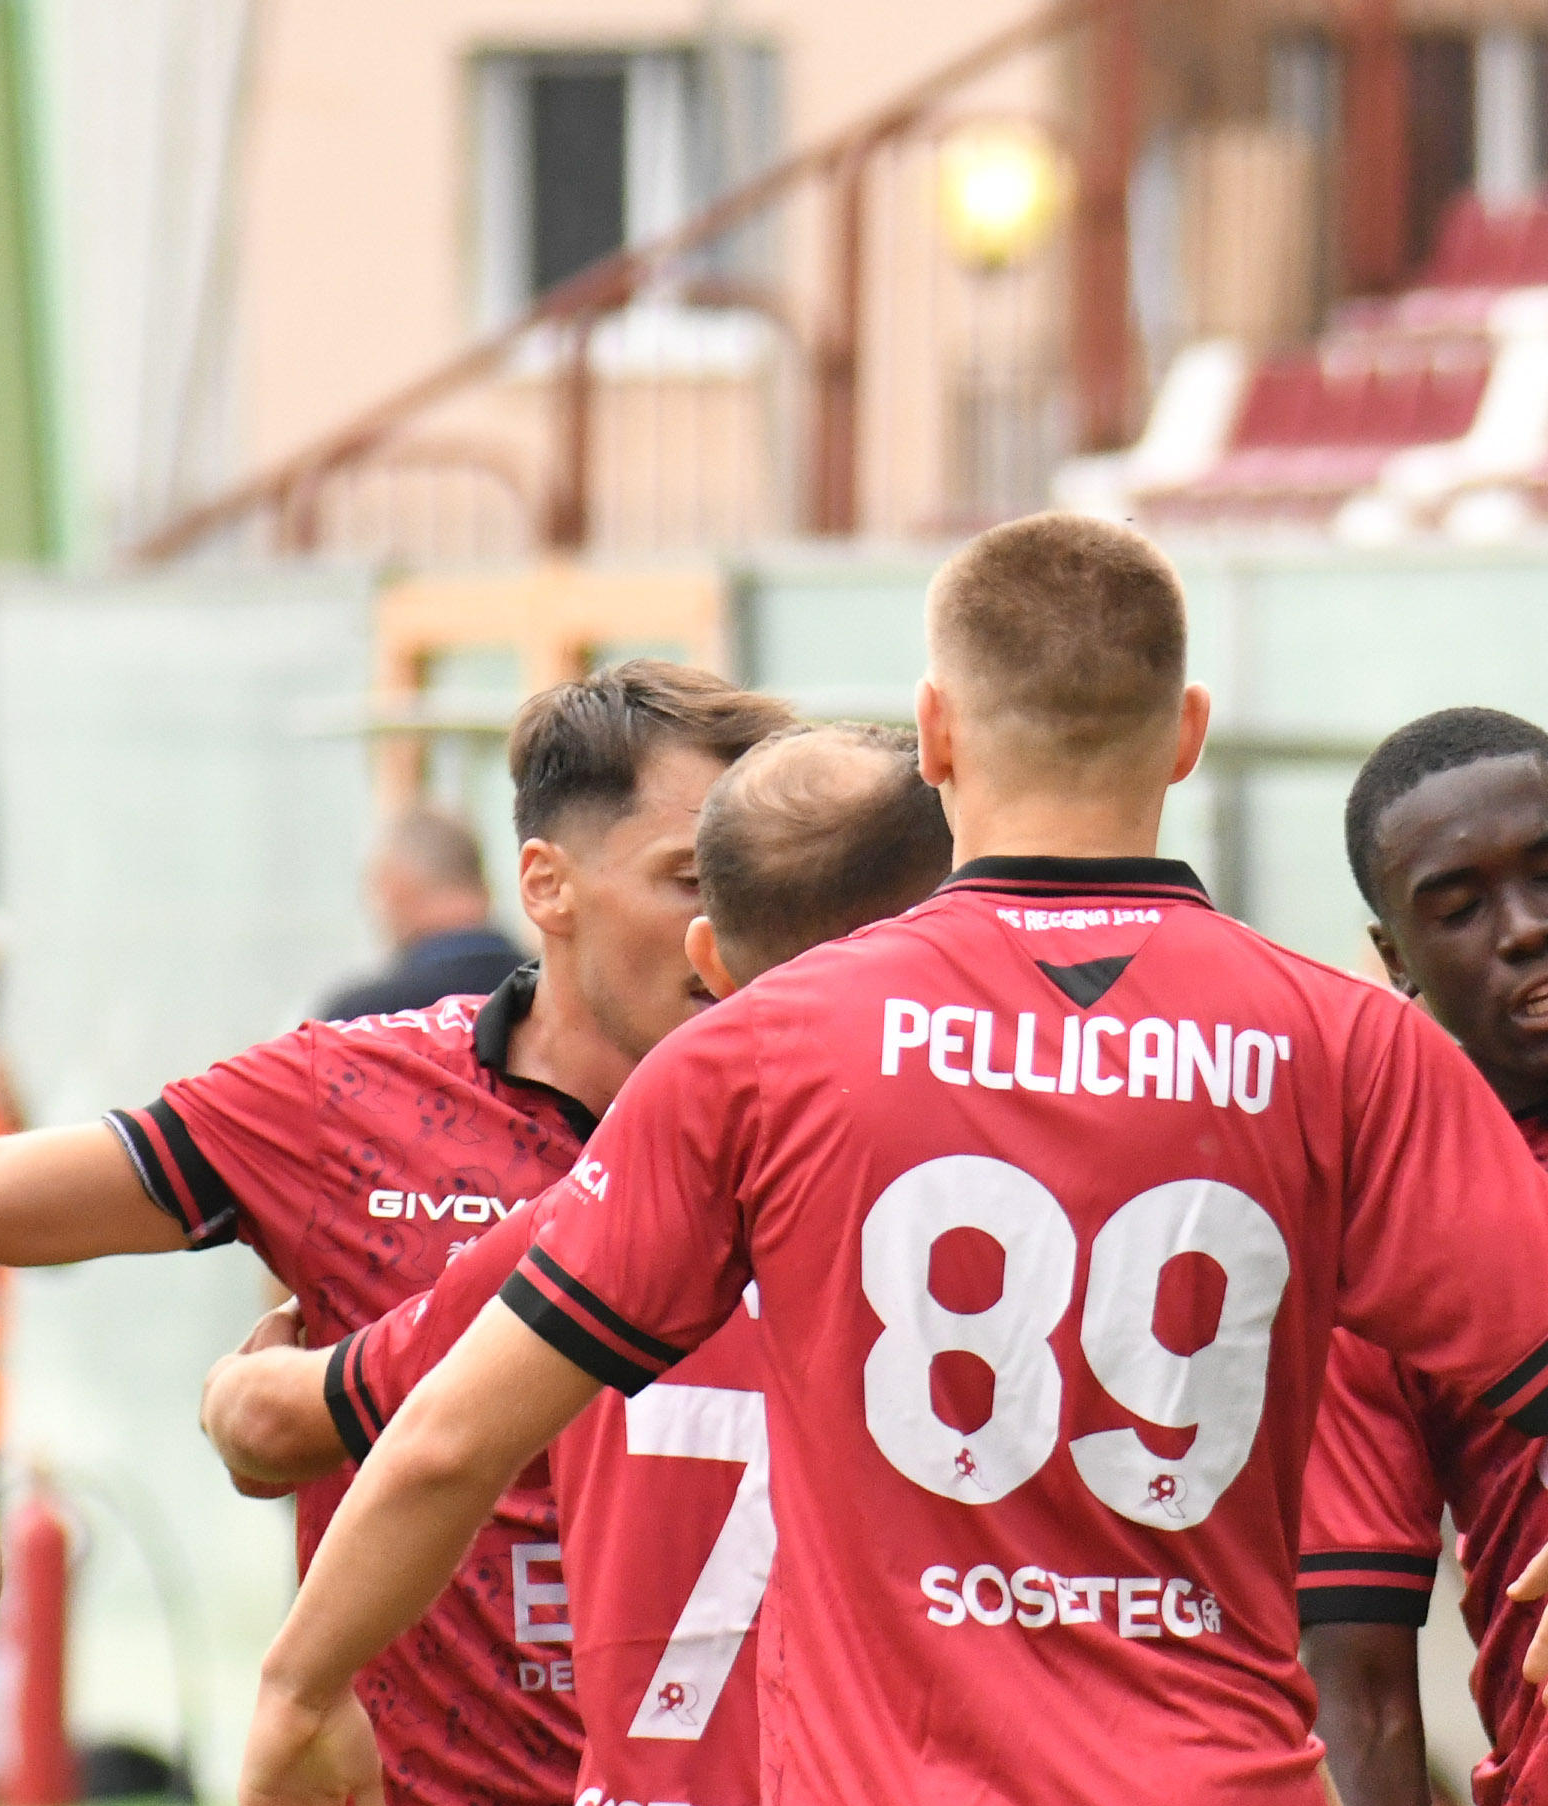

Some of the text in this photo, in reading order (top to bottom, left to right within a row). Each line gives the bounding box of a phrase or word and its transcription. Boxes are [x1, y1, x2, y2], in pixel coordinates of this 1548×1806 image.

[881, 998, 1292, 1115] PELLICANO'
[861, 1154, 1291, 1532] 89
[624, 1381, 779, 1741] 7
[920, 1563, 1204, 1639] SOSETEG
